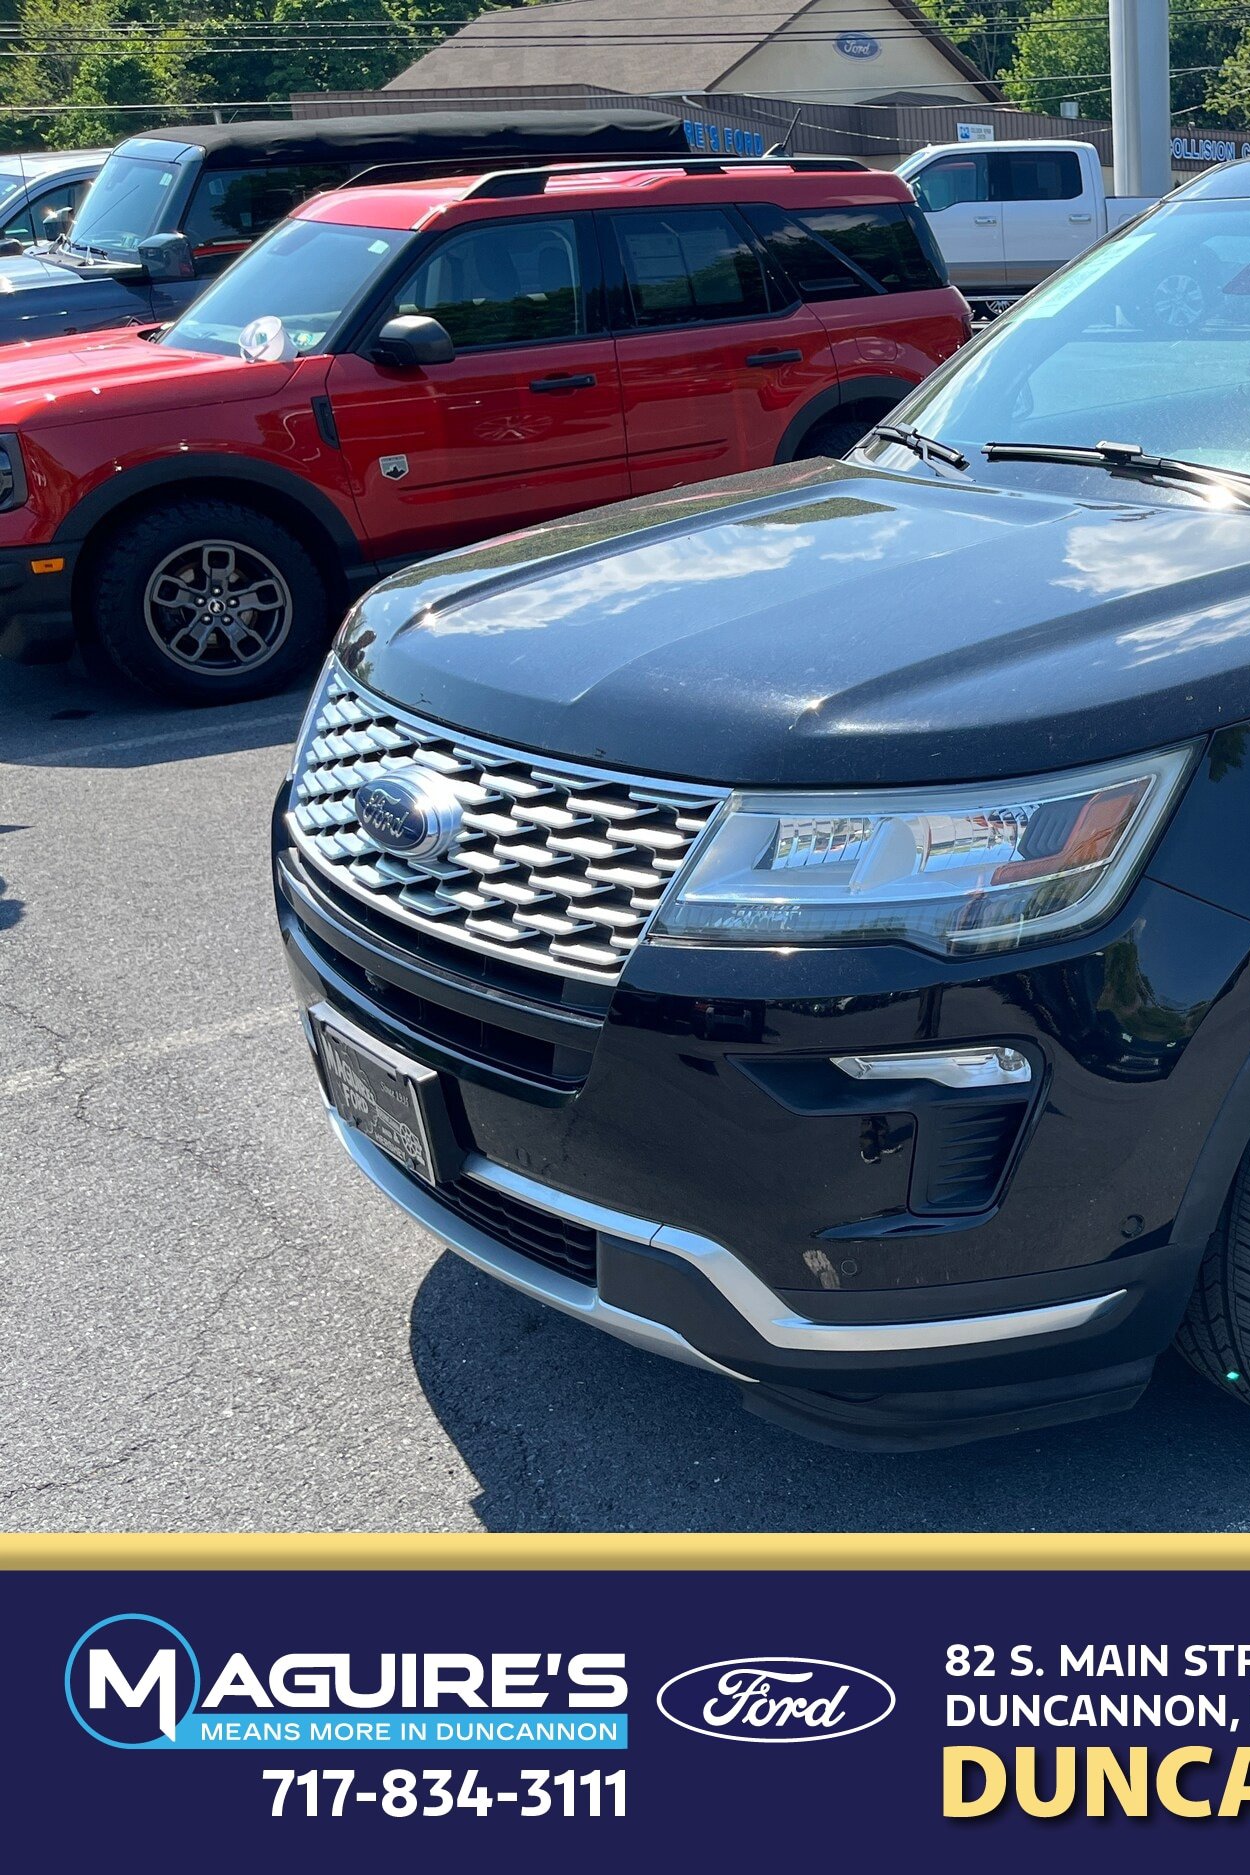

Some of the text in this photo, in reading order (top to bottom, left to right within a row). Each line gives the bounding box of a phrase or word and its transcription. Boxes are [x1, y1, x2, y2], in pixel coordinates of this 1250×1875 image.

[843, 36, 872, 55] Ford
[723, 127, 764, 156] FORD
[1170, 137, 1236, 161] OLLISION
